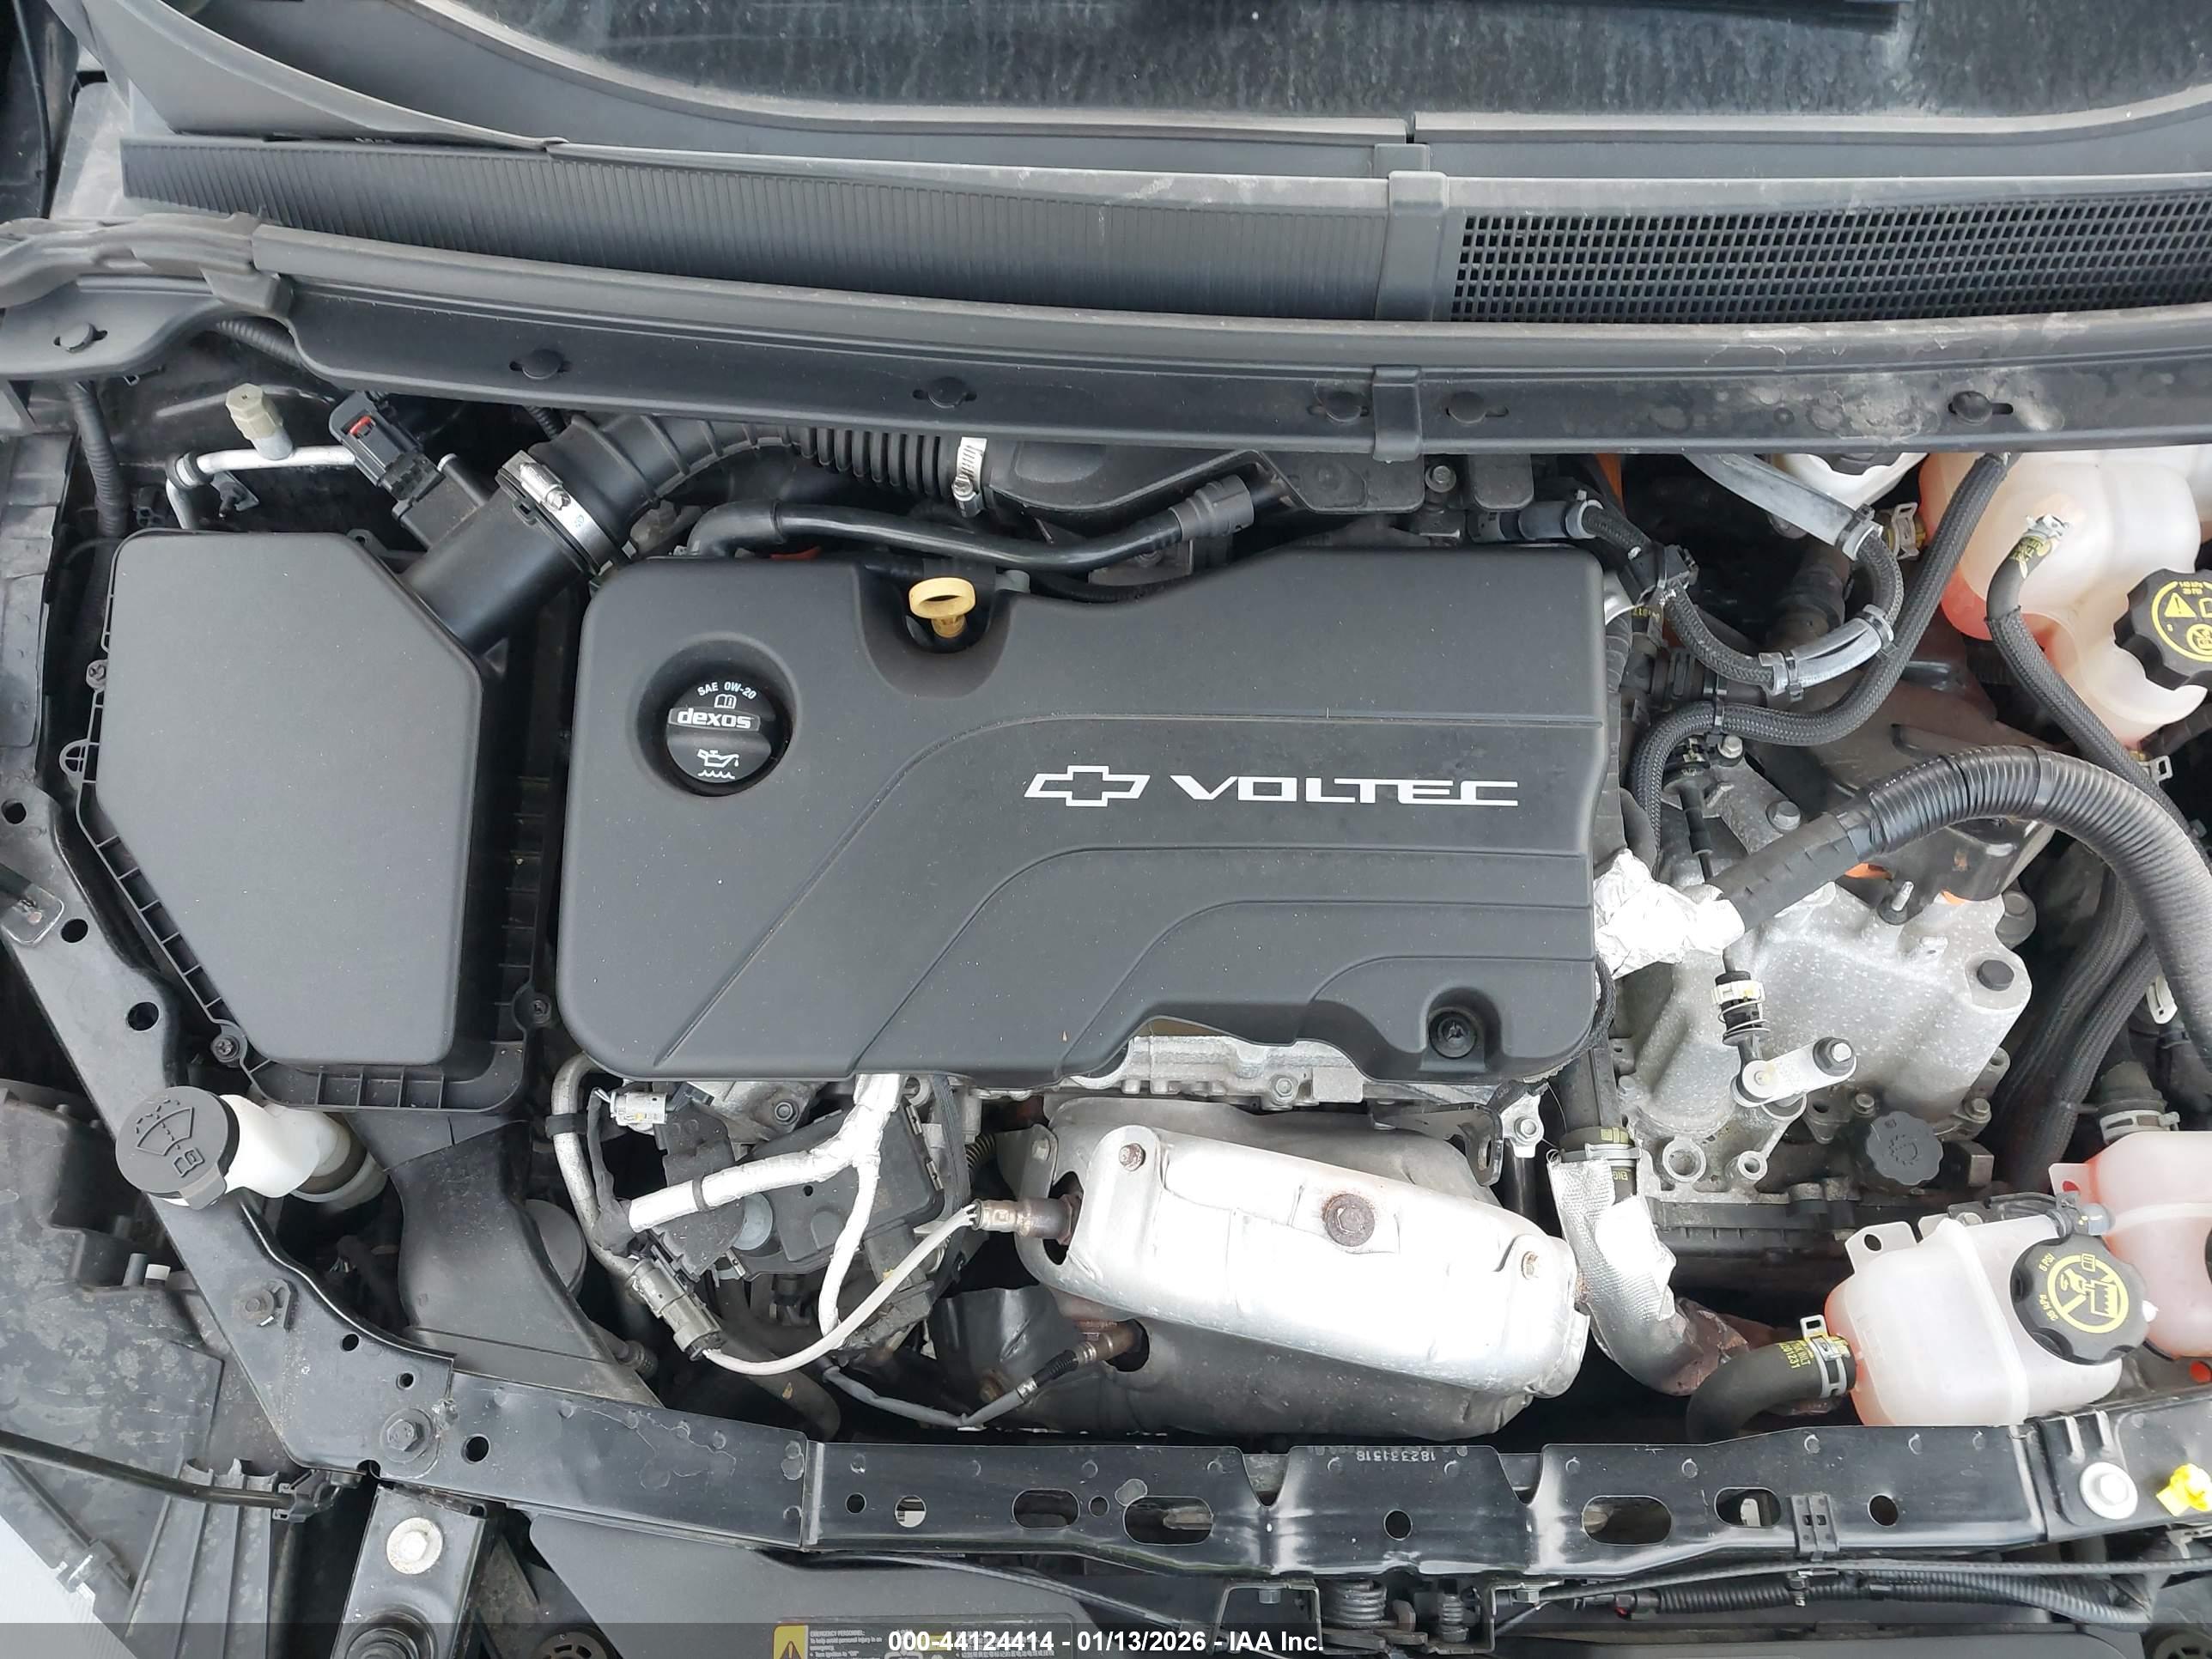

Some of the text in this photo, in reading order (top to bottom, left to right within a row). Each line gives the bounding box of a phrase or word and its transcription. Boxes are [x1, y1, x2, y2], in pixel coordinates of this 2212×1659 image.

[697, 681, 757, 701] SAE 0W-20
[677, 708, 752, 730] dexos
[1170, 775, 1518, 806] VOLTEC
[2042, 1253, 2055, 1267] PSI
